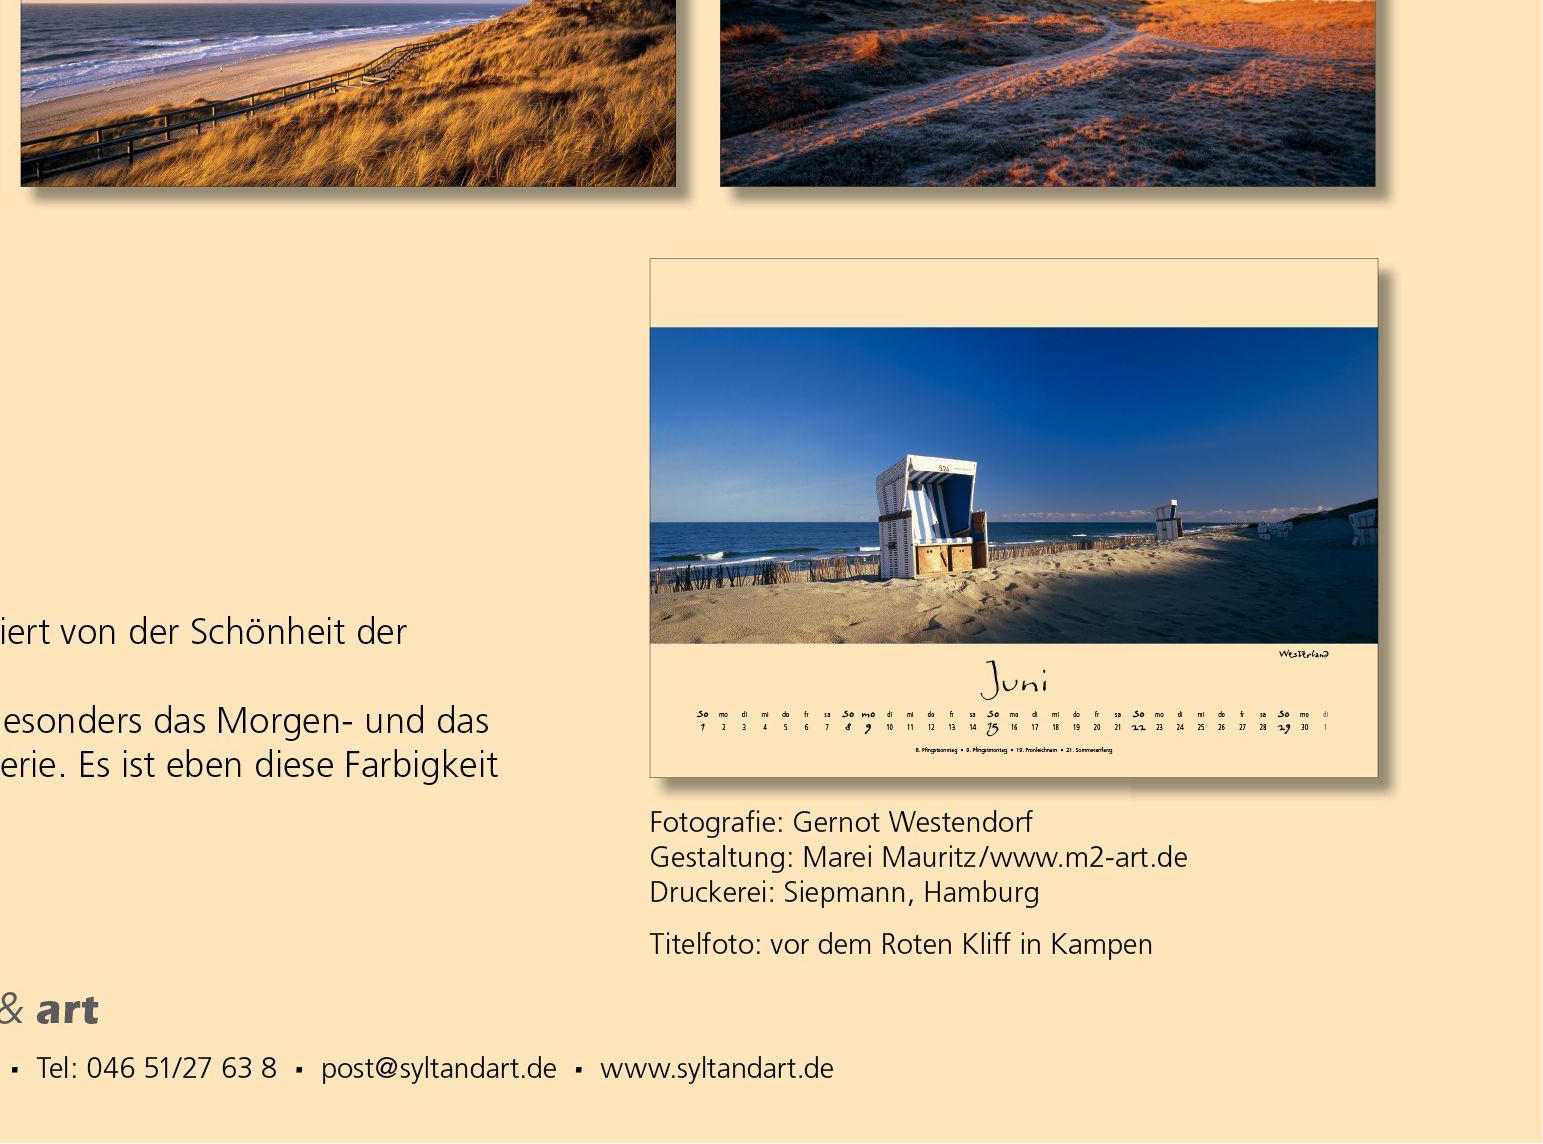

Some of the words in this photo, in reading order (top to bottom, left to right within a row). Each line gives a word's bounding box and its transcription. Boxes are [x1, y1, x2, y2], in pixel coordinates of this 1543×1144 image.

[59, 624, 116, 645] von
[129, 615, 180, 645] der
[191, 615, 346, 645] Schönheit
[357, 615, 408, 645] der
[979, 659, 1047, 701] Juni
[154, 704, 206, 734] das
[218, 706, 353, 742] Morgen-
[366, 704, 424, 734] und
[437, 704, 489, 734] das
[985, 721, 1000, 737] 15
[1130, 724, 1147, 732] 22
[1277, 723, 1291, 735] 29
[80, 750, 110, 778] Es
[123, 749, 156, 778] ist
[166, 748, 242, 778] eben
[255, 748, 334, 778] diese
[346, 748, 499, 786] Farbigkeit
[650, 809, 783, 839] Fotografie:
[793, 810, 881, 833] Gernot
[888, 809, 1034, 833] Westendorf
[650, 844, 793, 874] Gestaltung:
[803, 844, 872, 868] Marei
[650, 879, 774, 903] Druckerei:
[784, 879, 914, 909] Siepmann,
[924, 879, 1039, 909] Hamburg
[649, 931, 761, 955] Titelfoto:
[769, 938, 810, 955] vor
[818, 931, 871, 955] dem
[882, 932, 952, 955] Roten
[963, 931, 1012, 955] Kliff
[1021, 931, 1041, 955] in
[1051, 932, 1152, 961] Kampen
[36, 996, 100, 1025] art
[36, 1055, 77, 1079] Tel:
[87, 1056, 135, 1079] 046
[144, 1056, 212, 1079] 51/27
[222, 1056, 252, 1079] 63
[261, 1056, 277, 1079] 8
[322, 1055, 557, 1085] post@syltandart.de
[599, 1055, 834, 1085] www.syltandart.de
